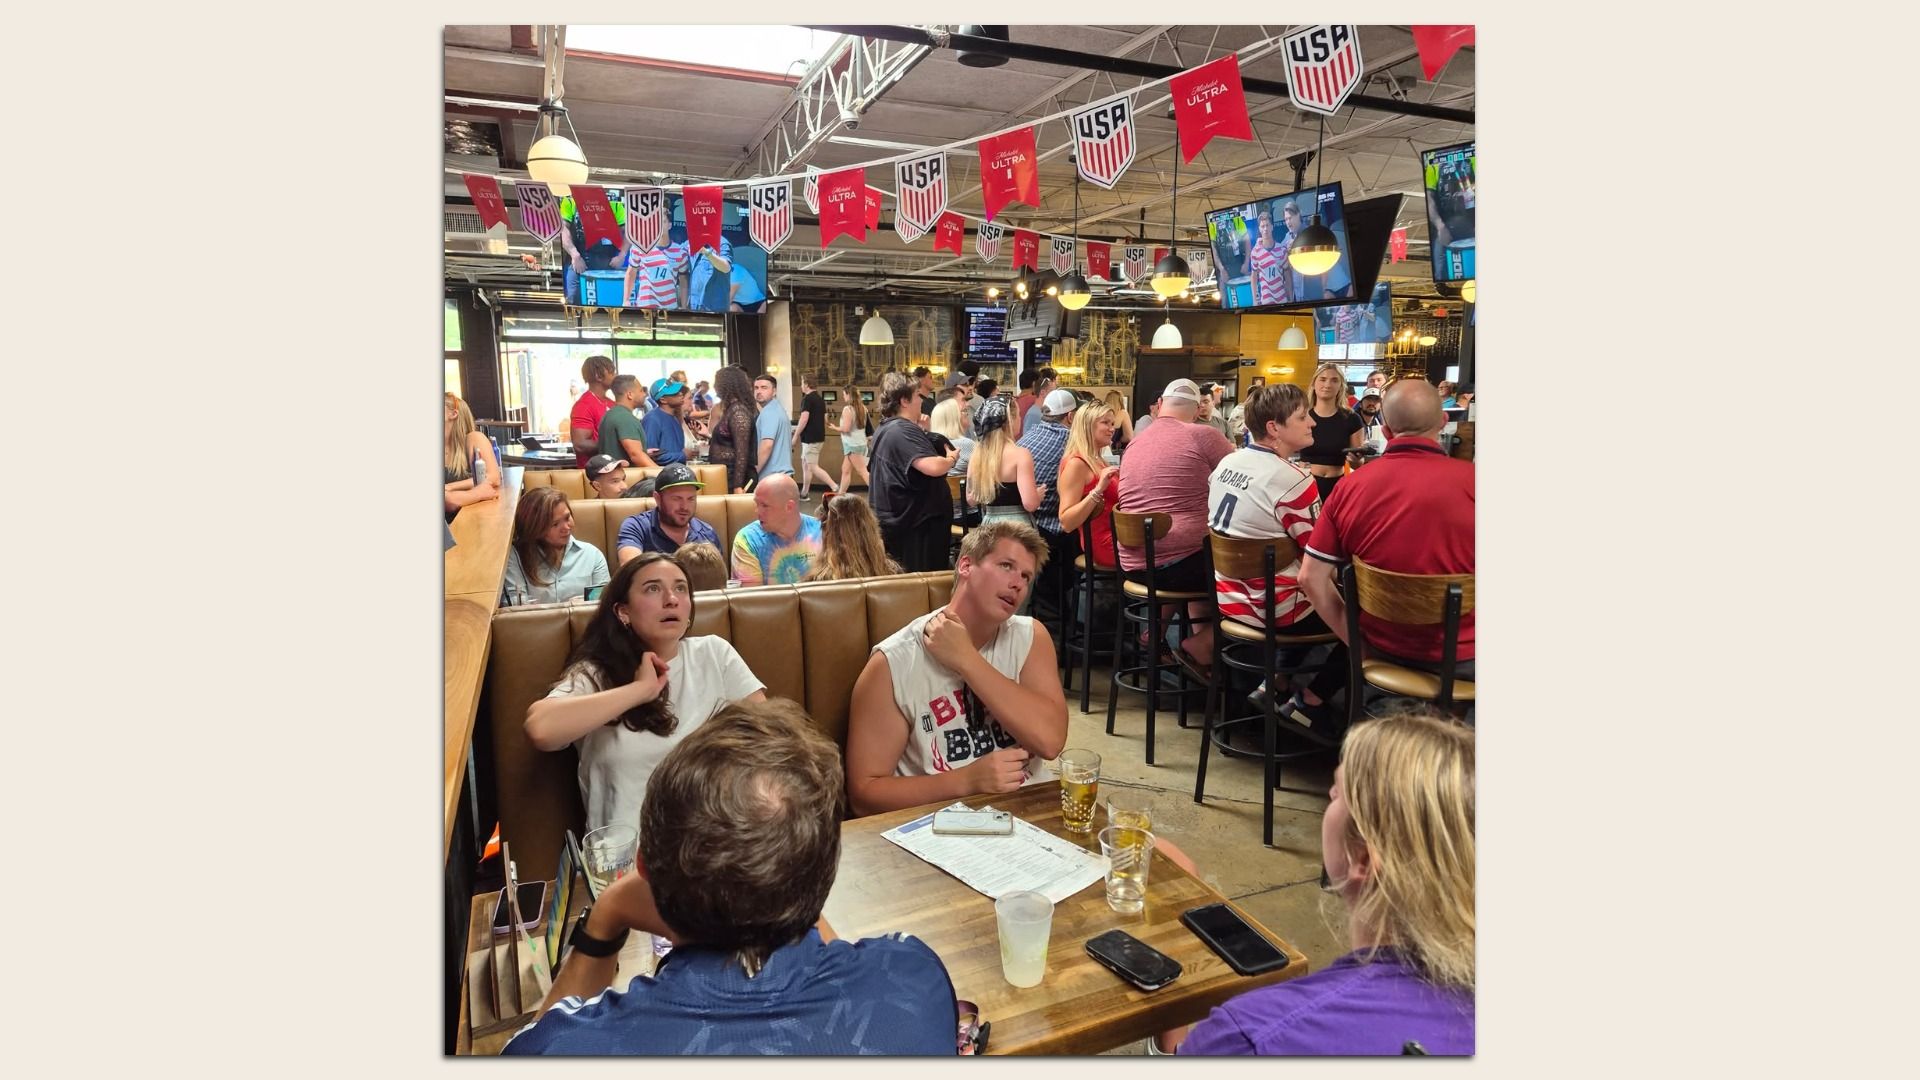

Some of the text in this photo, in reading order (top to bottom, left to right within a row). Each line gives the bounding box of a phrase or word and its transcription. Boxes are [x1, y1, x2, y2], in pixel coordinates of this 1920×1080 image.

[1290, 25, 1349, 62] USA
[1186, 83, 1229, 107] ULTRA
[1079, 102, 1126, 139] USA
[991, 154, 1026, 170] ULTRA
[901, 157, 941, 189] USA
[519, 187, 550, 209] USA
[629, 192, 660, 217] USA
[753, 185, 787, 212] USA
[827, 191, 857, 203] ULTRA
[583, 204, 606, 212] ULTRA
[692, 207, 717, 215] ULTRA
[942, 223, 960, 232] ULTRA
[981, 224, 1001, 240] USA
[1054, 239, 1073, 254] USA
[1126, 248, 1145, 262] USA
[654, 266, 668, 280] 14
[1268, 266, 1277, 279] 14
[1217, 468, 1254, 490] ADAMS
